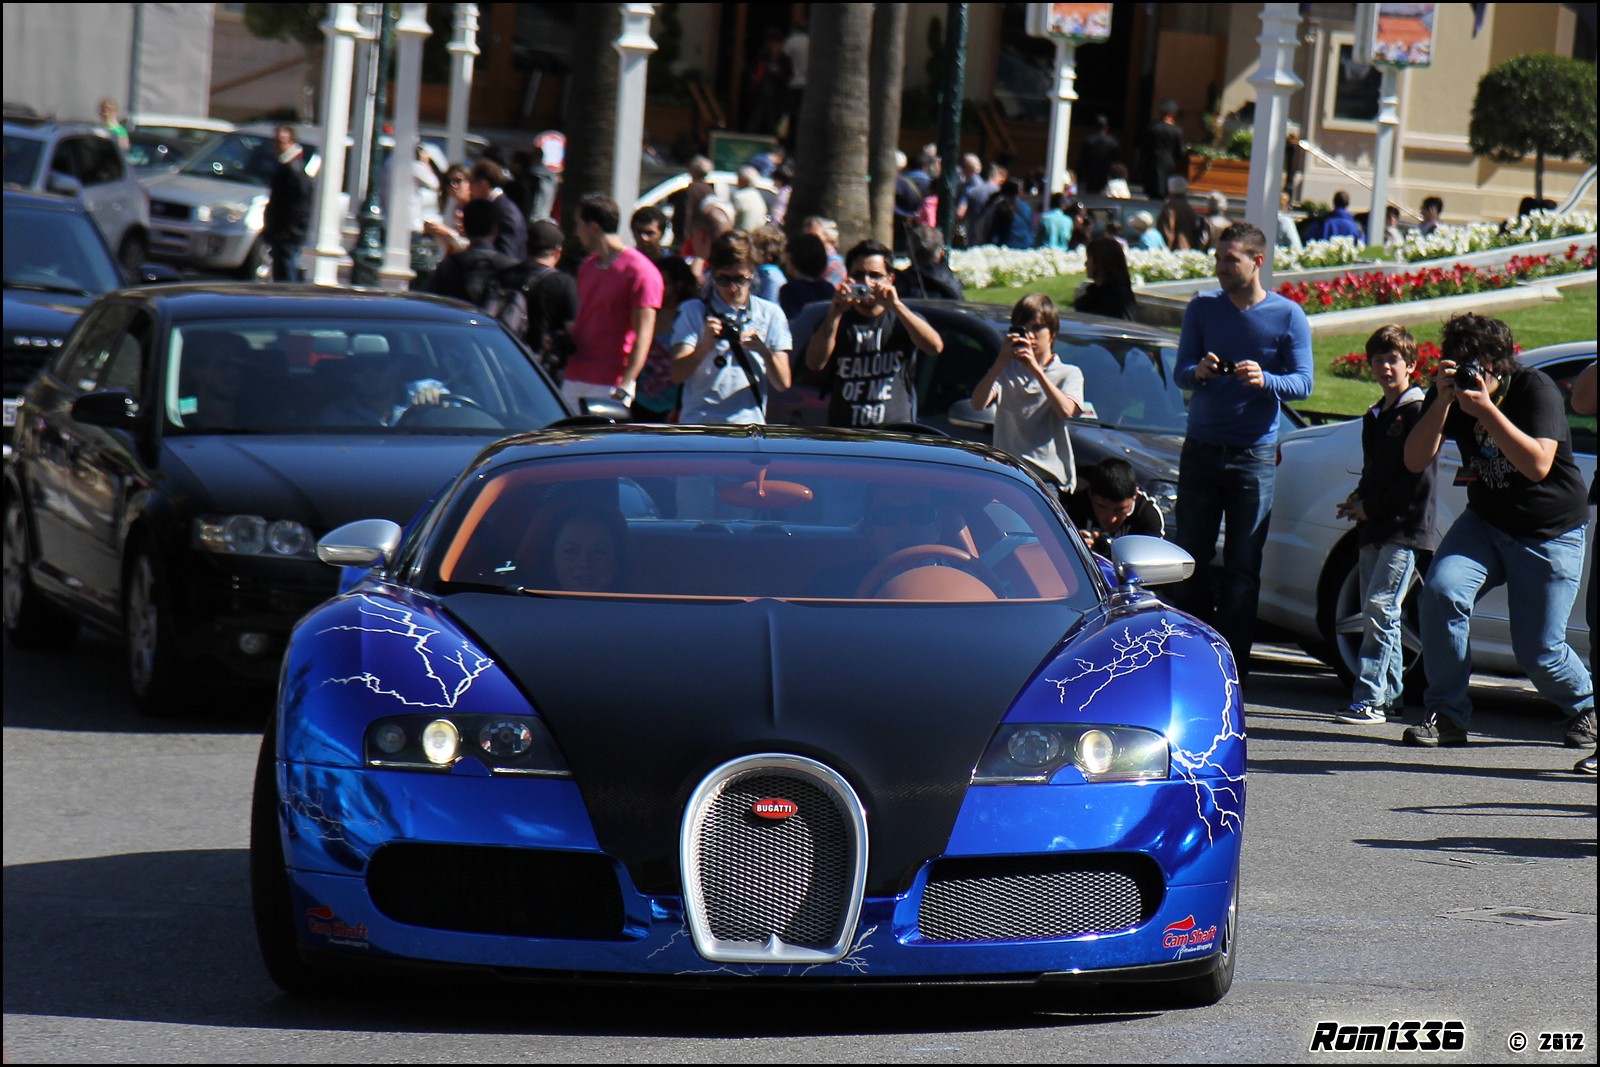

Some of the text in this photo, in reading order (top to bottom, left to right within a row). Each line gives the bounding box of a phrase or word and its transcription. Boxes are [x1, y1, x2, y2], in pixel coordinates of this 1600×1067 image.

[836, 352, 905, 378] EALOUS
[842, 378, 893, 400] OF ME
[850, 404, 886, 426] TOO
[756, 804, 792, 813] BUGATTI
[1162, 932, 1189, 948] Cam
[1188, 925, 1217, 945] Shaft
